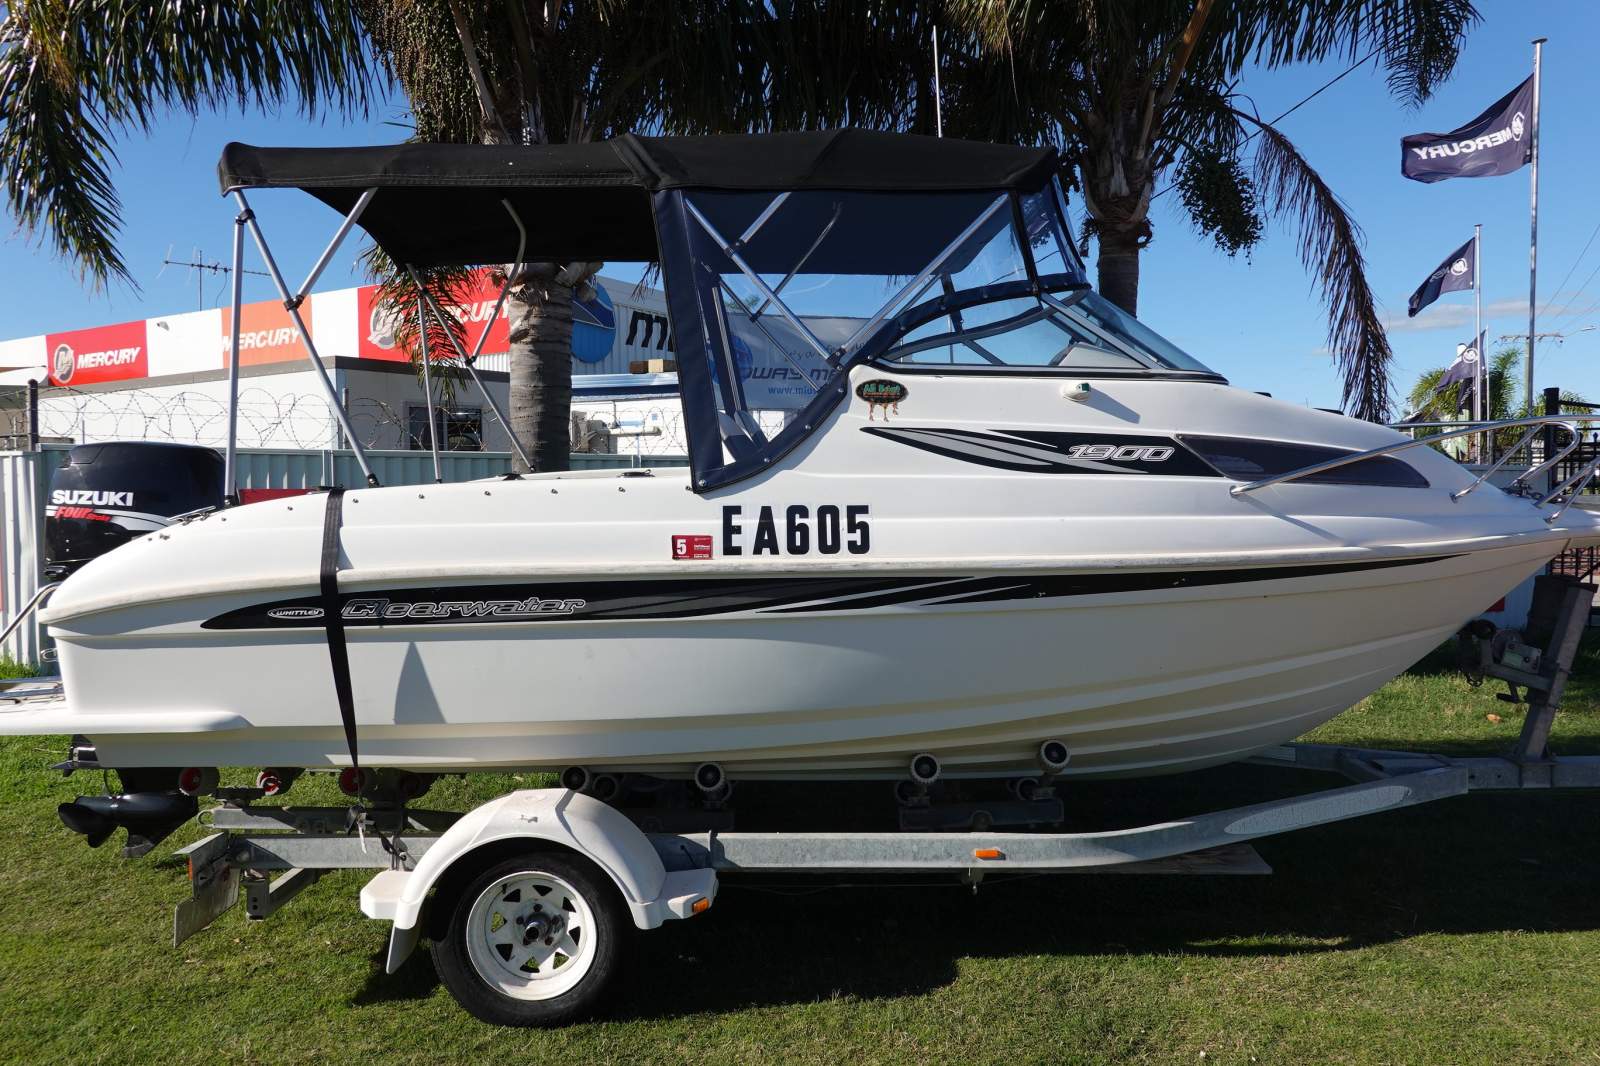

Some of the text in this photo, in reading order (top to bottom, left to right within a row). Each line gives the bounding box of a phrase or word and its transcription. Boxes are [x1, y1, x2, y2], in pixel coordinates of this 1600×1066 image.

[76, 346, 141, 369] MERCURY
[1067, 444, 1175, 462] 1900
[52, 489, 134, 507] SUZUKI
[55, 505, 94, 519] FOUR
[676, 538, 688, 555] 5
[275, 608, 320, 616] WHITTLEY
[341, 597, 586, 619] Clearwater
